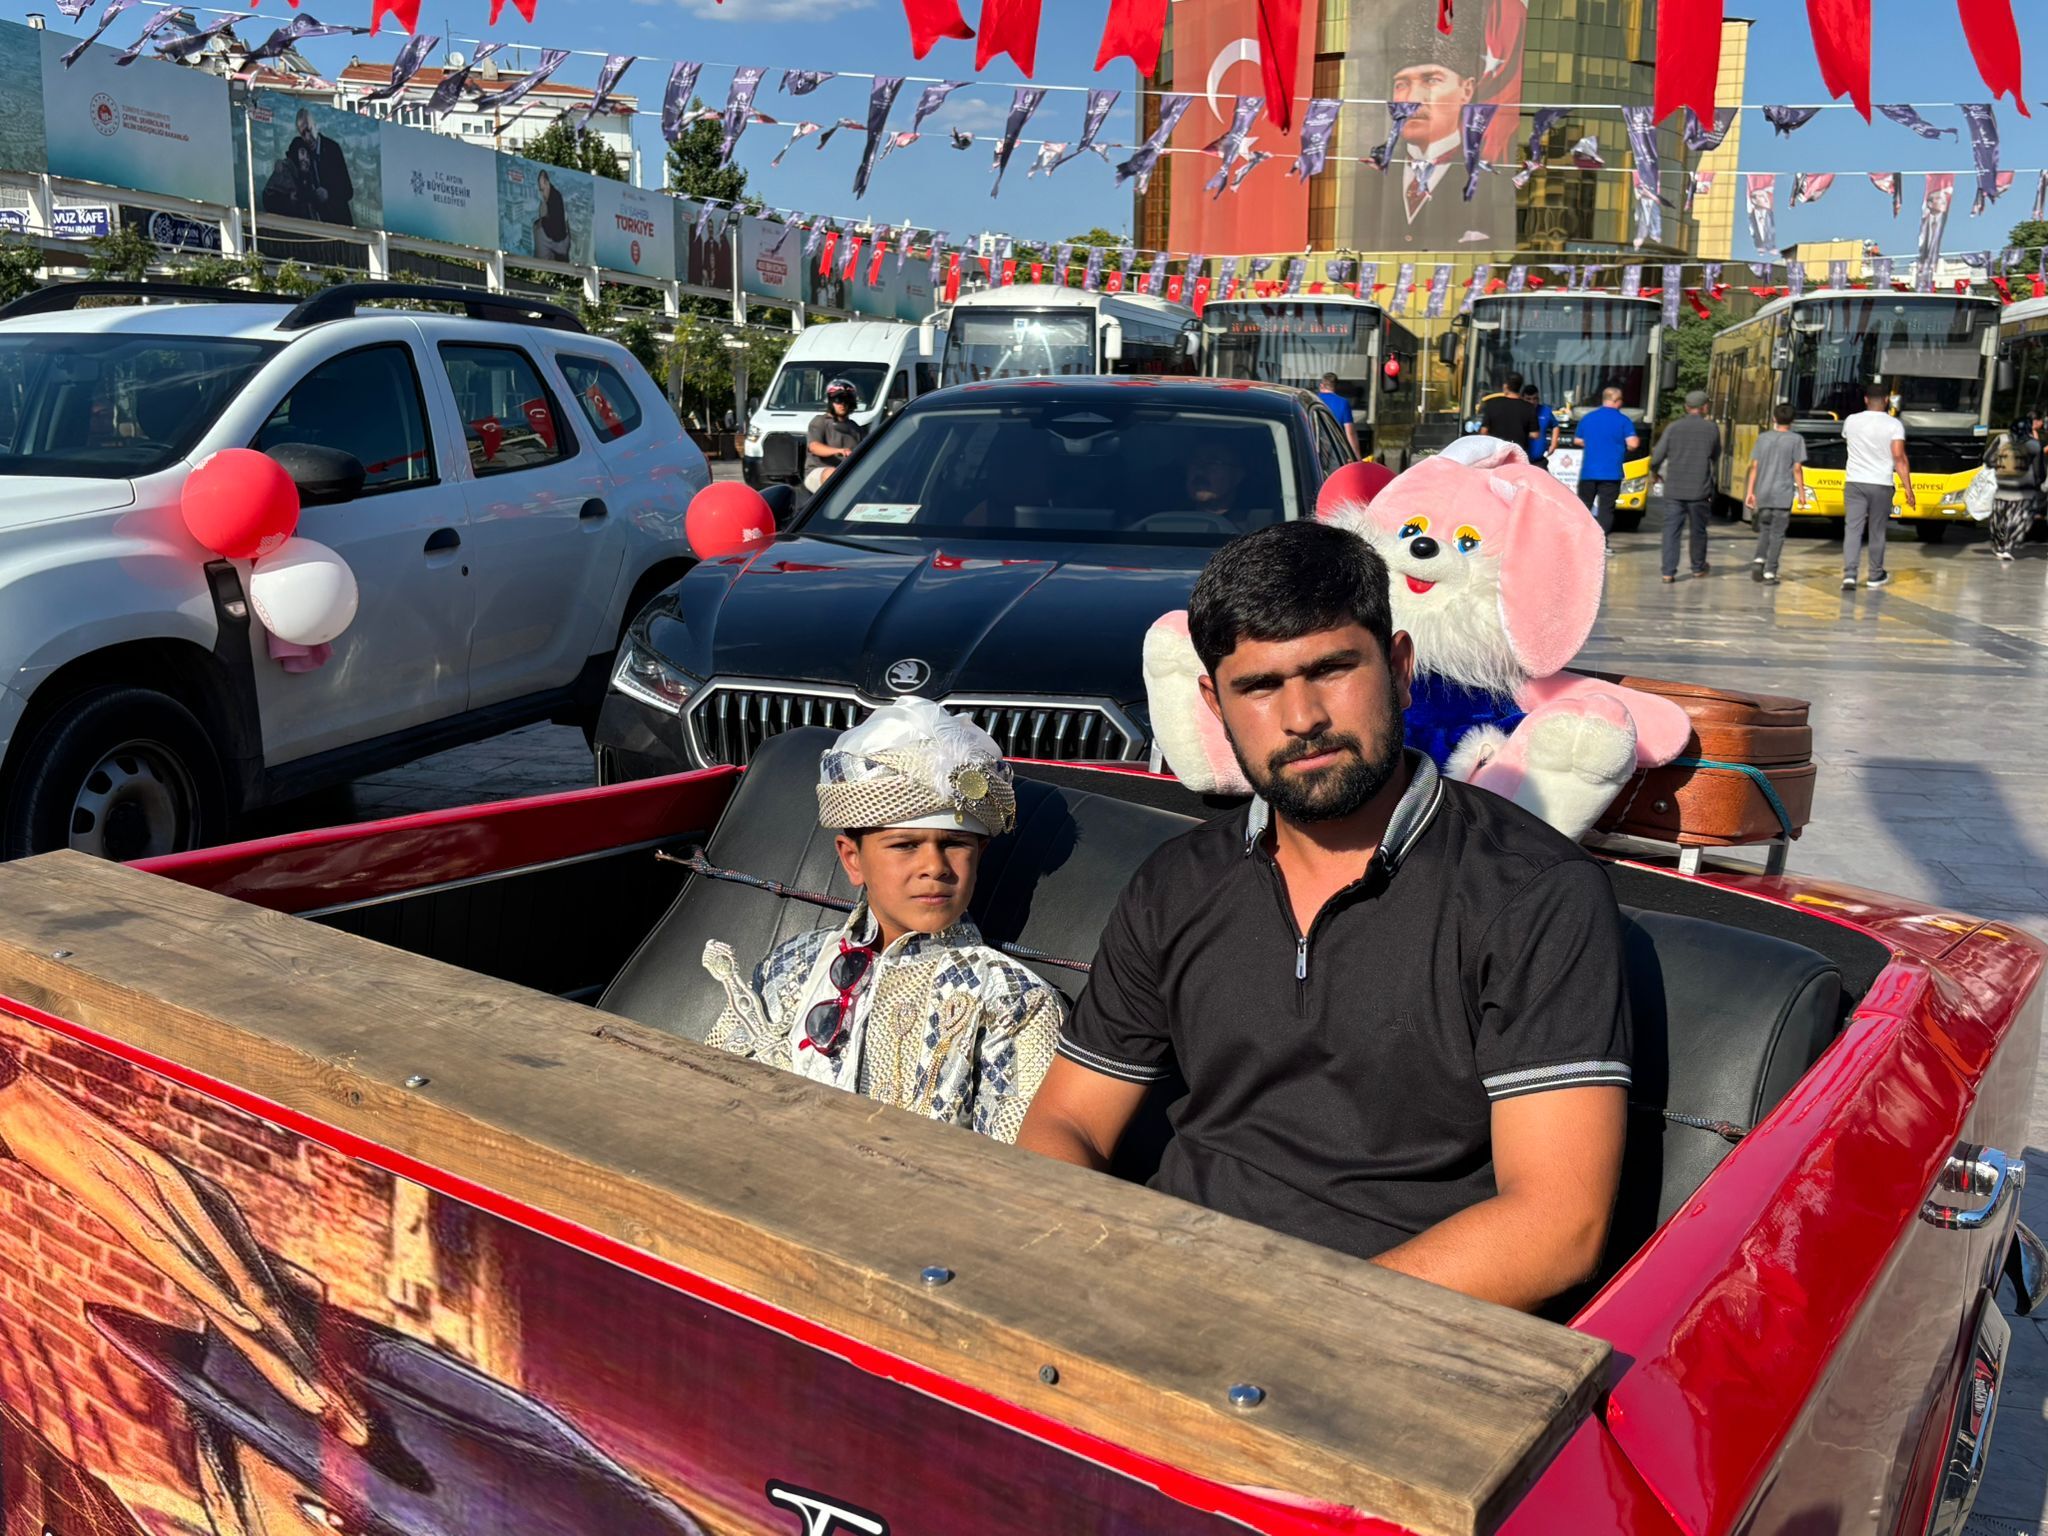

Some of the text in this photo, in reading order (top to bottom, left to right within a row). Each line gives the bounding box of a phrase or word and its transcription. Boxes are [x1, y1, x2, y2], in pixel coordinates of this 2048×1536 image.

[446, 175, 463, 185] AYDIN
[427, 180, 470, 198] BÜYÜKŞEHİR
[433, 194, 466, 207] BELEDİYESİ
[77, 211, 104, 223] KAFE
[615, 213, 655, 238] TÜRKİYE
[1817, 479, 1842, 487] AYDIN
